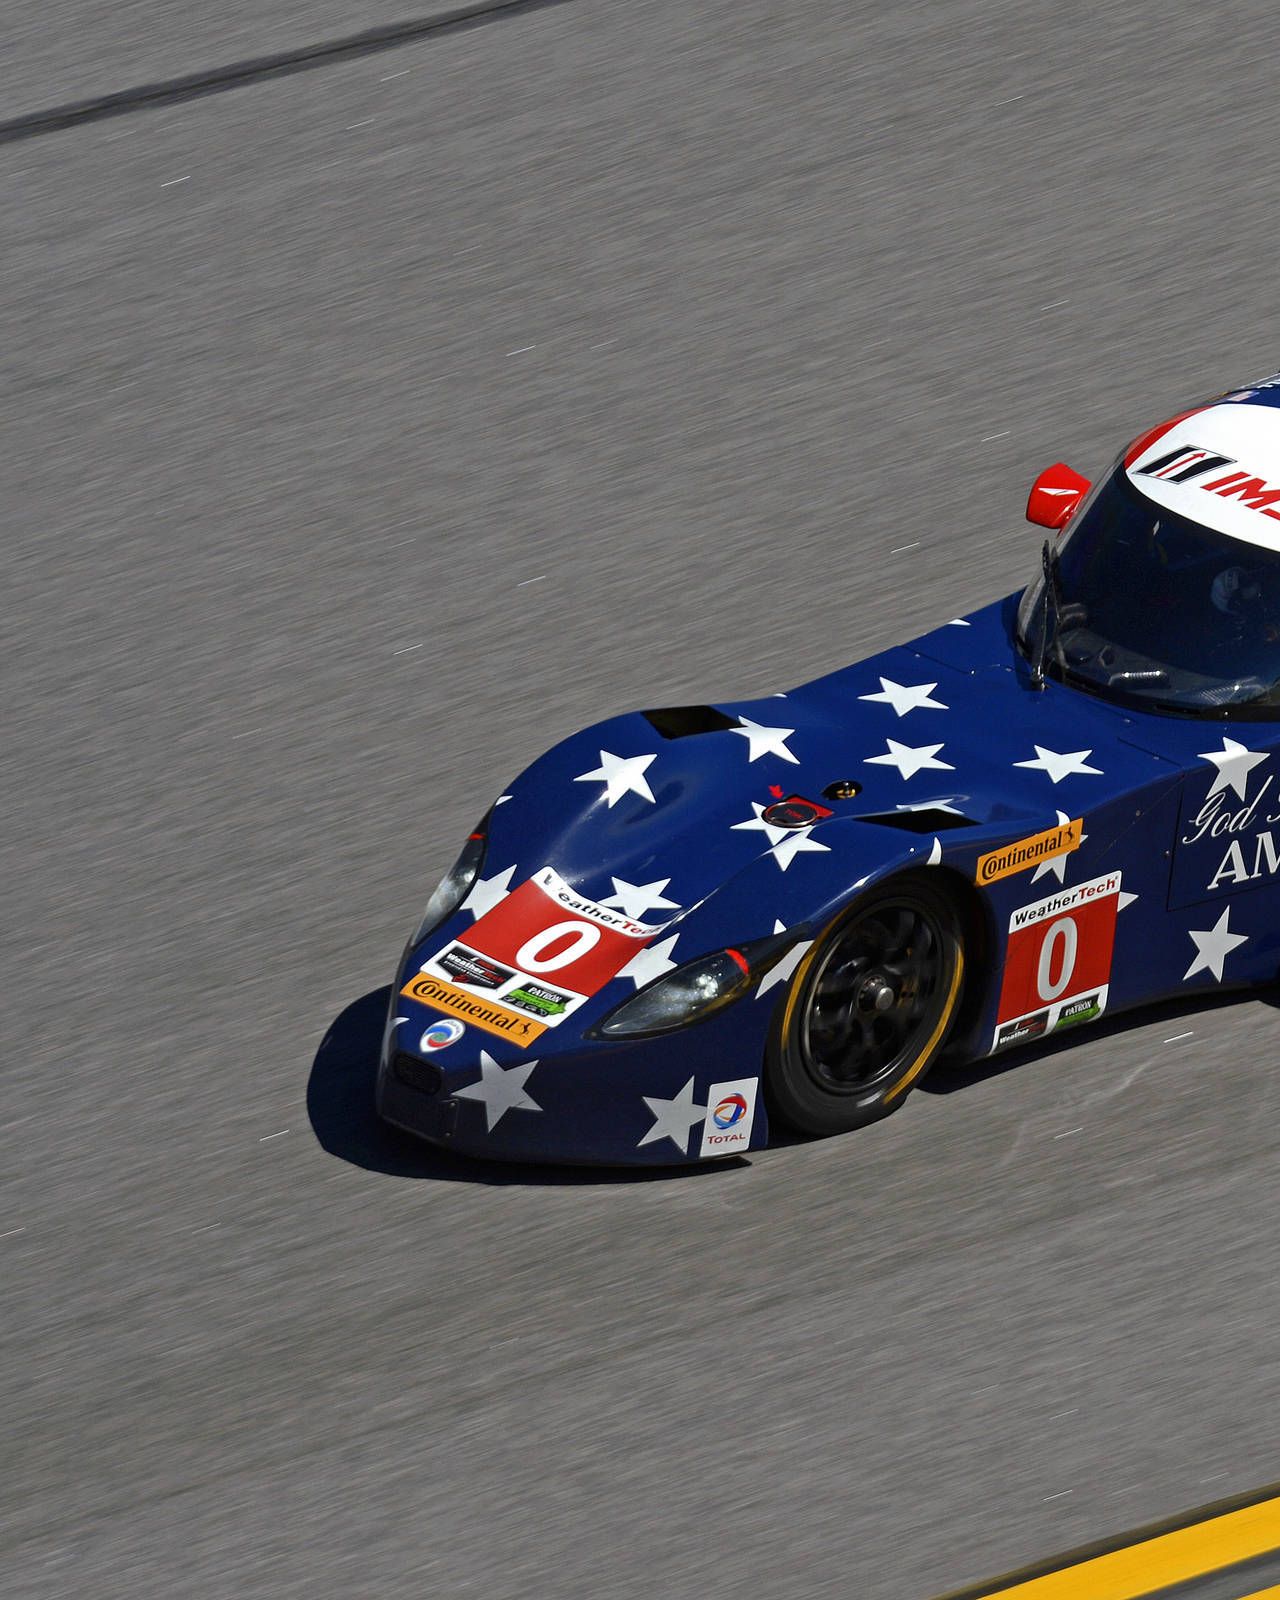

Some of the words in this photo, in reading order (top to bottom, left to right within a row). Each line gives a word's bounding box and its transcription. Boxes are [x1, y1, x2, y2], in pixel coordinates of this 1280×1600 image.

[1182, 775, 1273, 844] God
[982, 831, 1063, 880] Continental
[1015, 878, 1115, 926] WeatherTech
[515, 920, 601, 973] 0
[1037, 916, 1078, 1001] 0
[412, 980, 517, 1030] Continental
[708, 1133, 746, 1144] TOTAL
